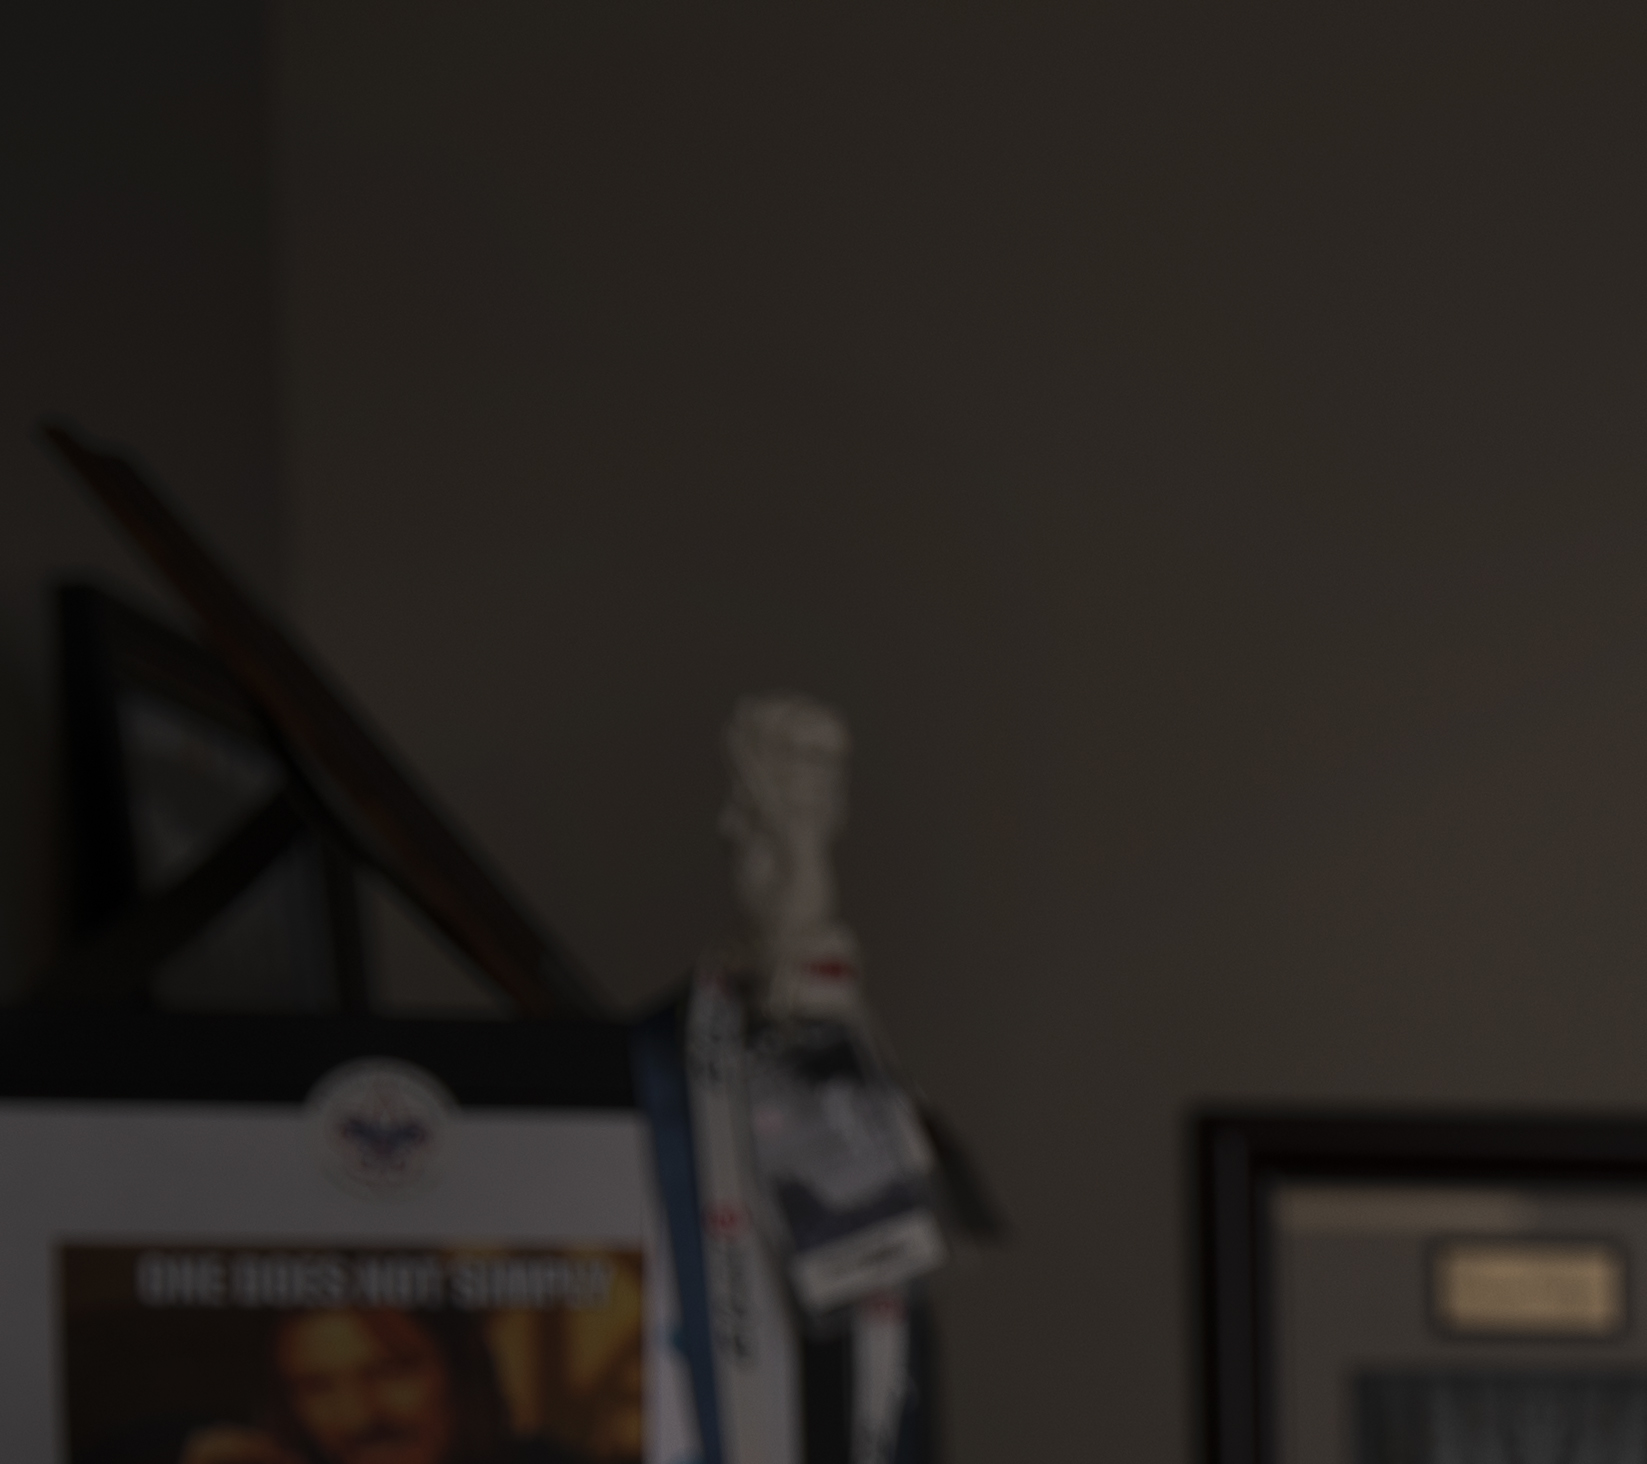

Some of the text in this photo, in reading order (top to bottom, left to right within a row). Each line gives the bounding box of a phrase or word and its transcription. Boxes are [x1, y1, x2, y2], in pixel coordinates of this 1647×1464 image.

[141, 1256, 613, 1311] ONE DOES NOT SIMPLY
